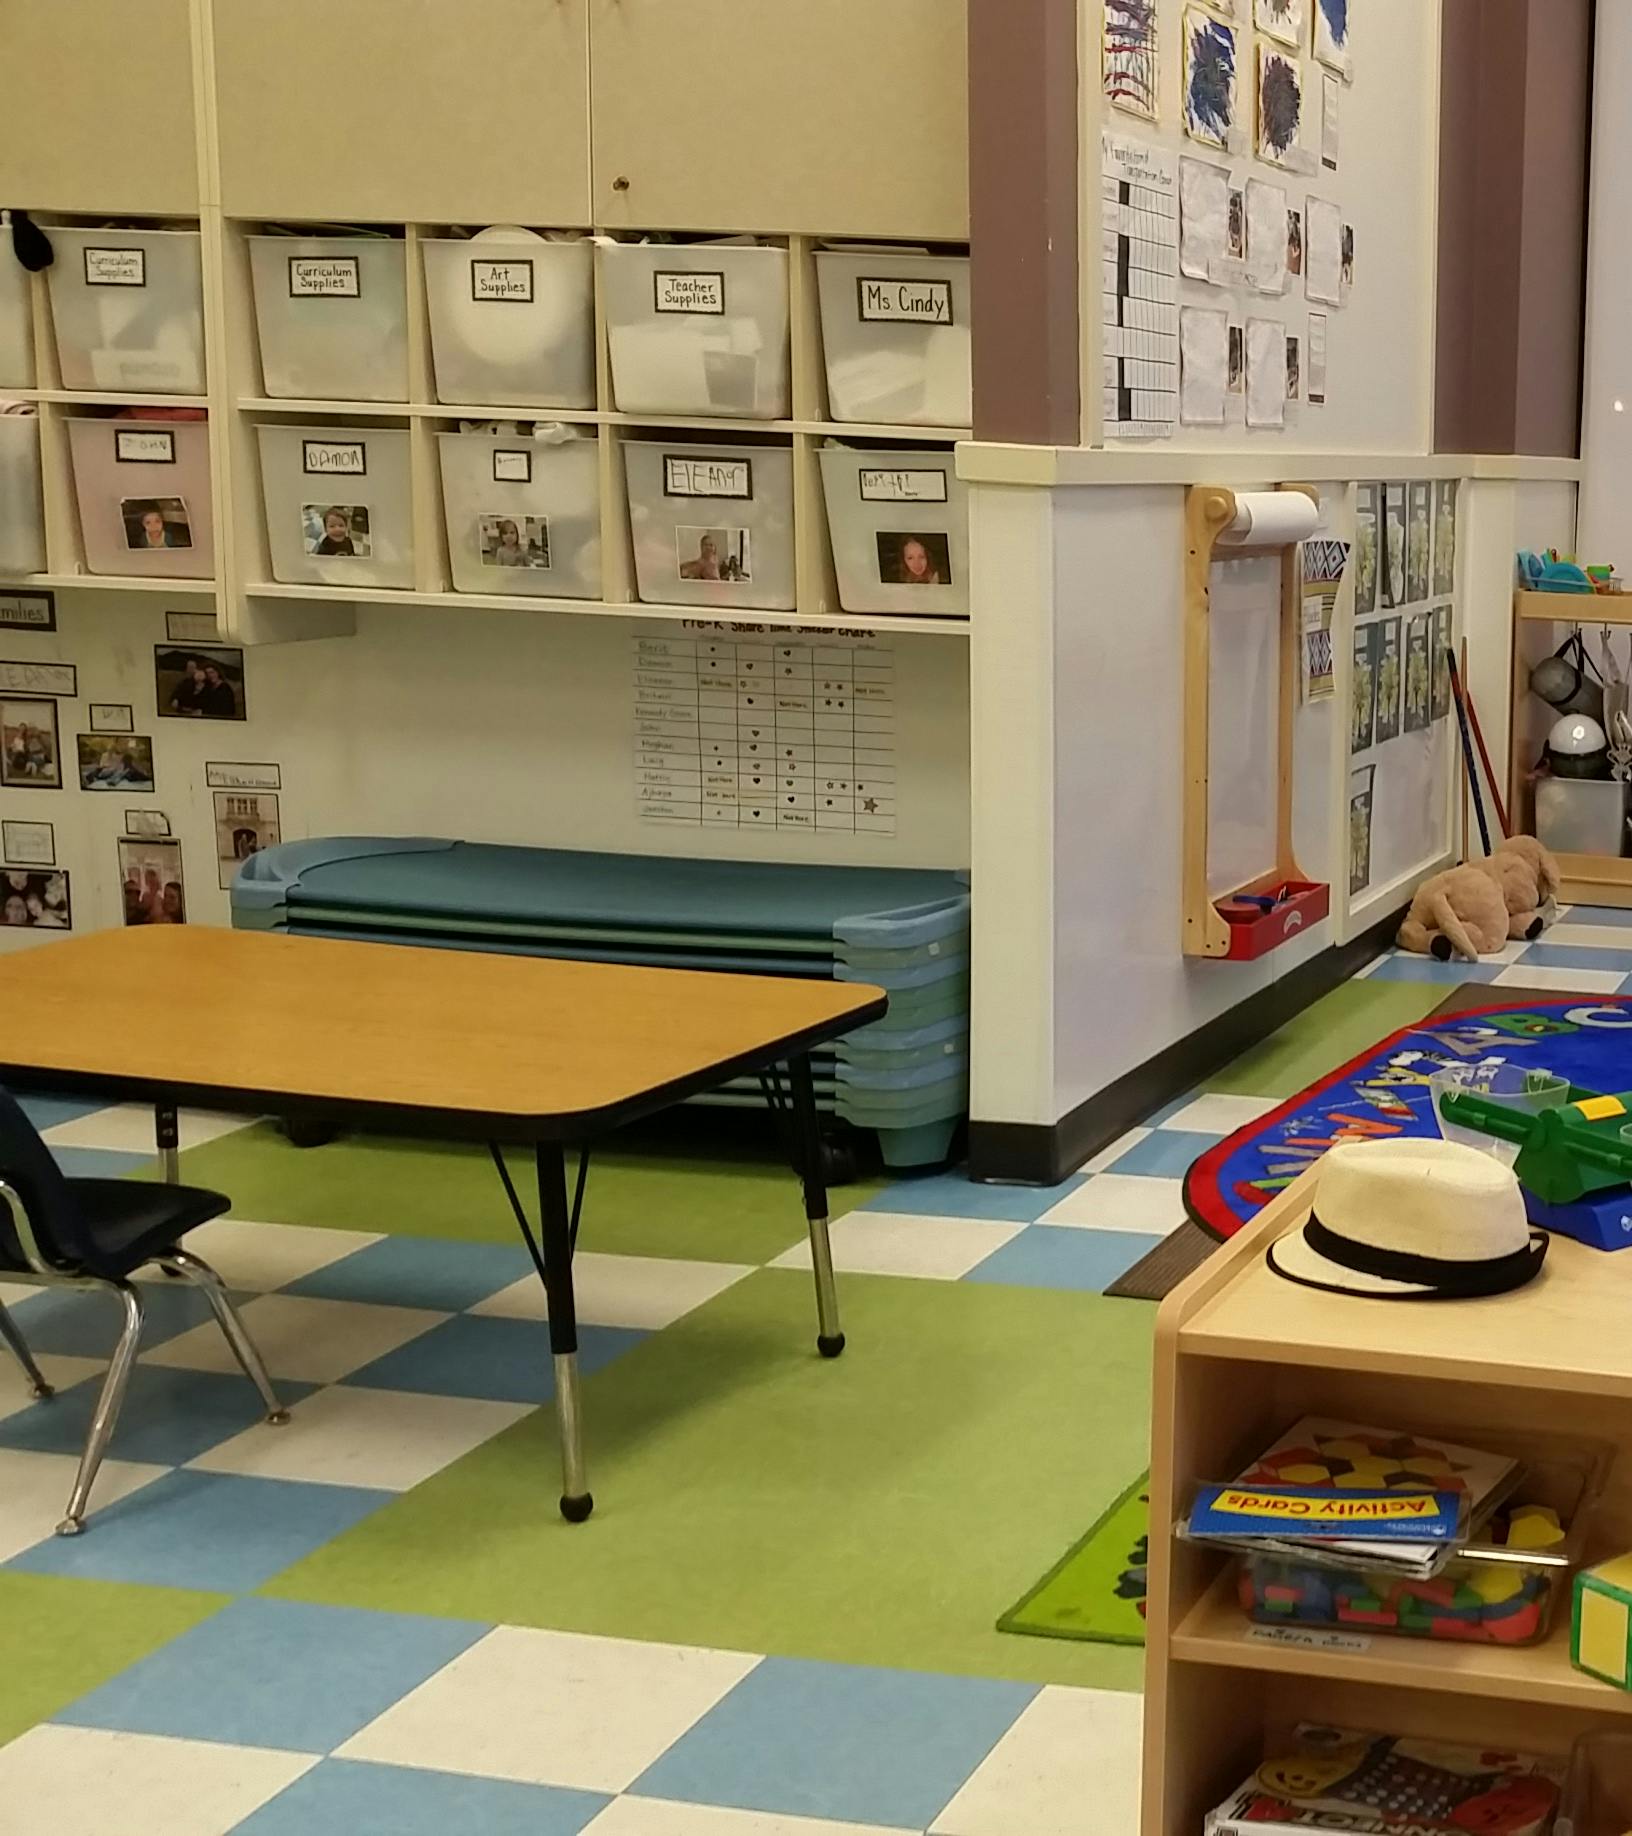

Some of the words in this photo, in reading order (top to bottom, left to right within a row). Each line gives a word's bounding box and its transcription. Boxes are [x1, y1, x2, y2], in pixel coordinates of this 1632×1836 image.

[296, 263, 352, 277] Curriculum
[490, 267, 510, 280] Art
[300, 276, 345, 292] Supplies
[480, 278, 526, 296] Supplies
[668, 279, 714, 292] Teacher
[665, 290, 717, 308] Supplies
[898, 286, 945, 320] Cindy
[0, 600, 45, 621] milies
[1481, 1012, 1582, 1038] B
[1226, 1494, 1312, 1515] Cards
[1320, 1499, 1426, 1516] Activity
